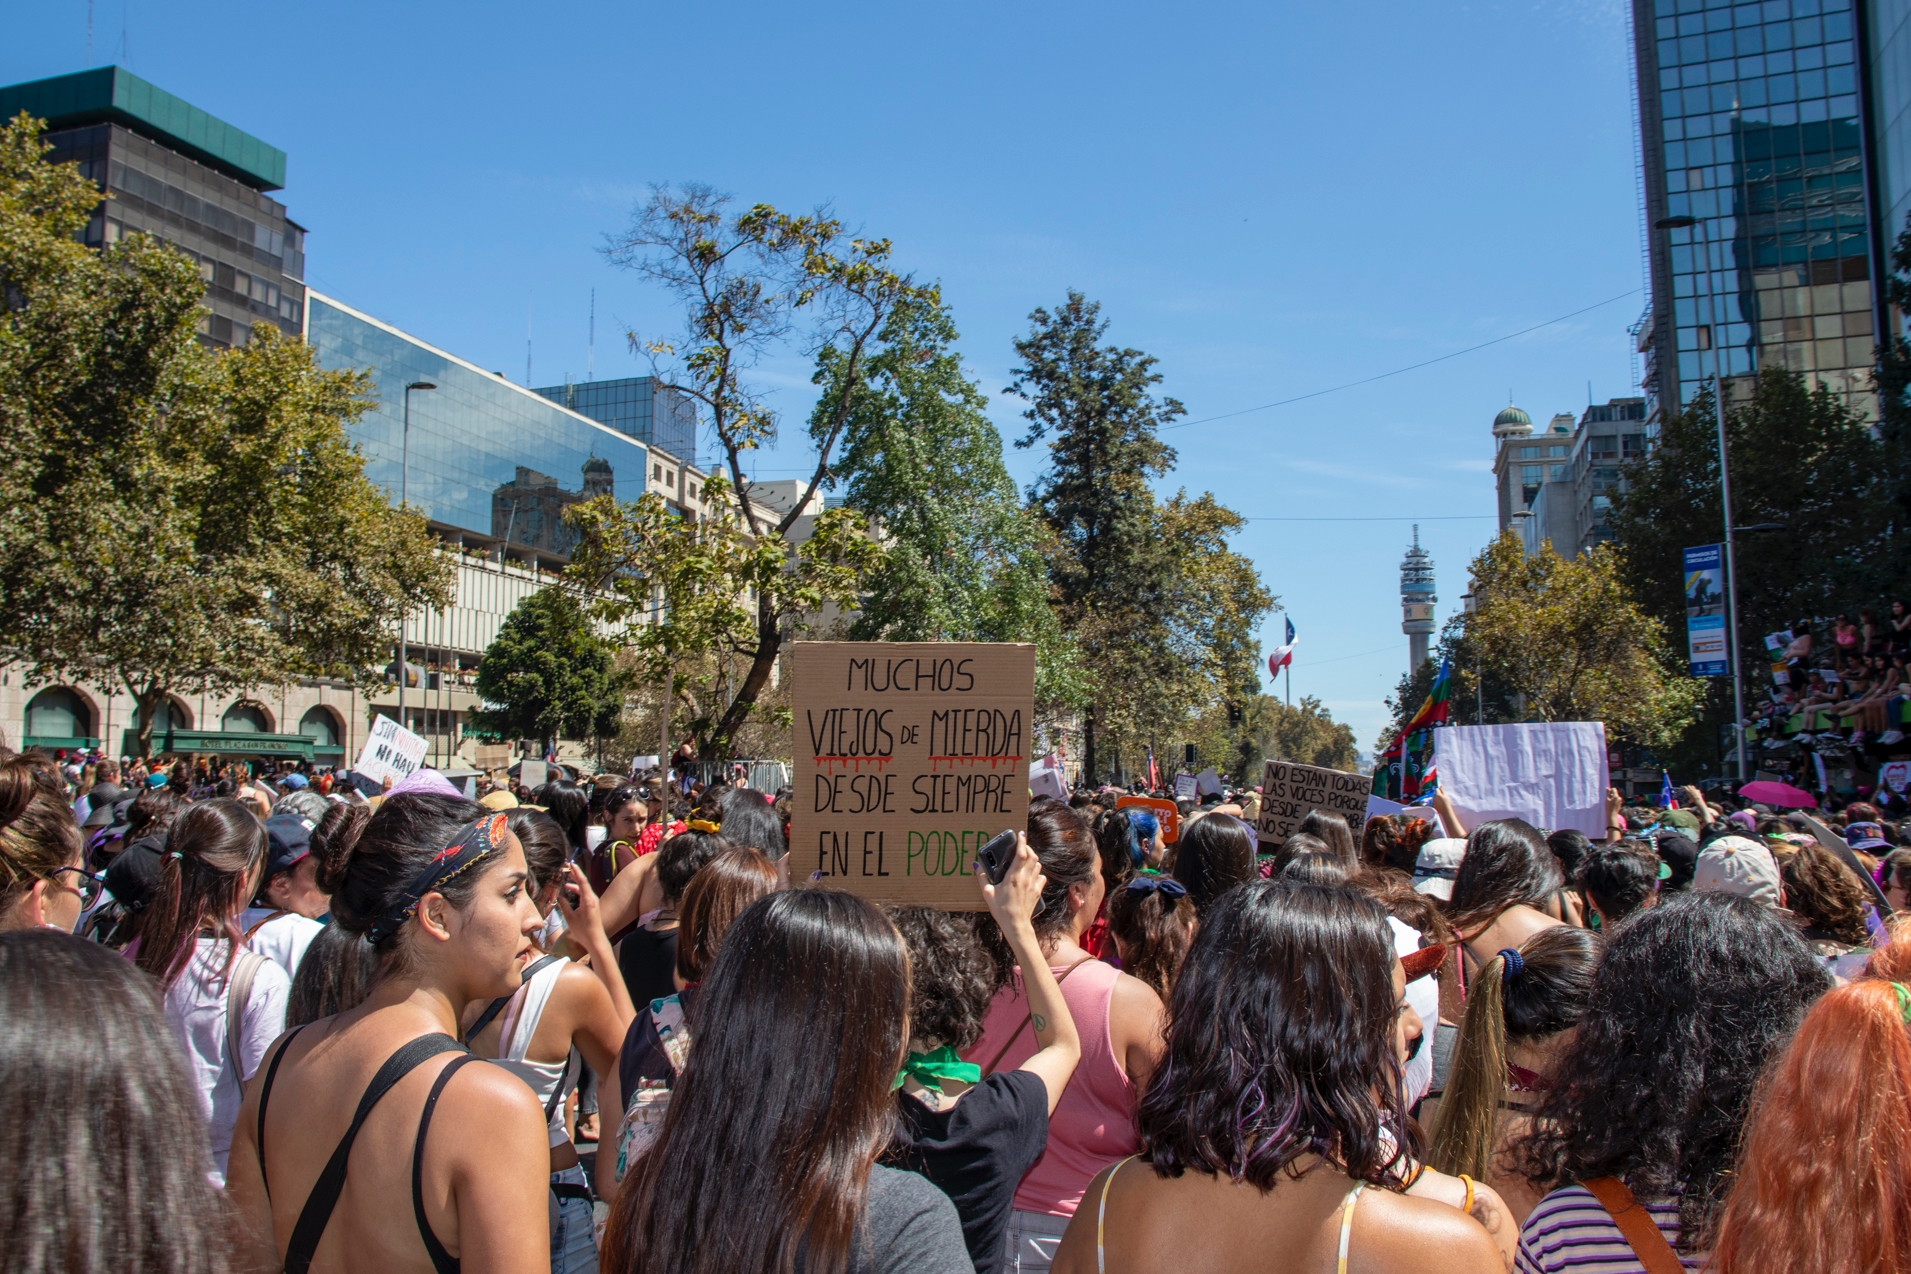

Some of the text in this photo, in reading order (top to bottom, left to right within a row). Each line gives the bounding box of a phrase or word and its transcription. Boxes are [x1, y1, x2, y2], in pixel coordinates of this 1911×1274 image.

[847, 658, 975, 692] MUCHOS
[807, 708, 1021, 757] VIEJOS DE MIERDA
[814, 774, 1016, 814] DESDE SIEMPRE
[1268, 764, 1286, 780] NO
[1328, 774, 1370, 795] TODAS
[1261, 797, 1302, 819] DESDE
[1263, 781, 1286, 798] LAS
[1327, 791, 1367, 813] PORQUE
[1257, 818, 1275, 834] NO
[1276, 821, 1294, 838] SE
[819, 831, 849, 877] EN
[862, 831, 890, 877] EL
